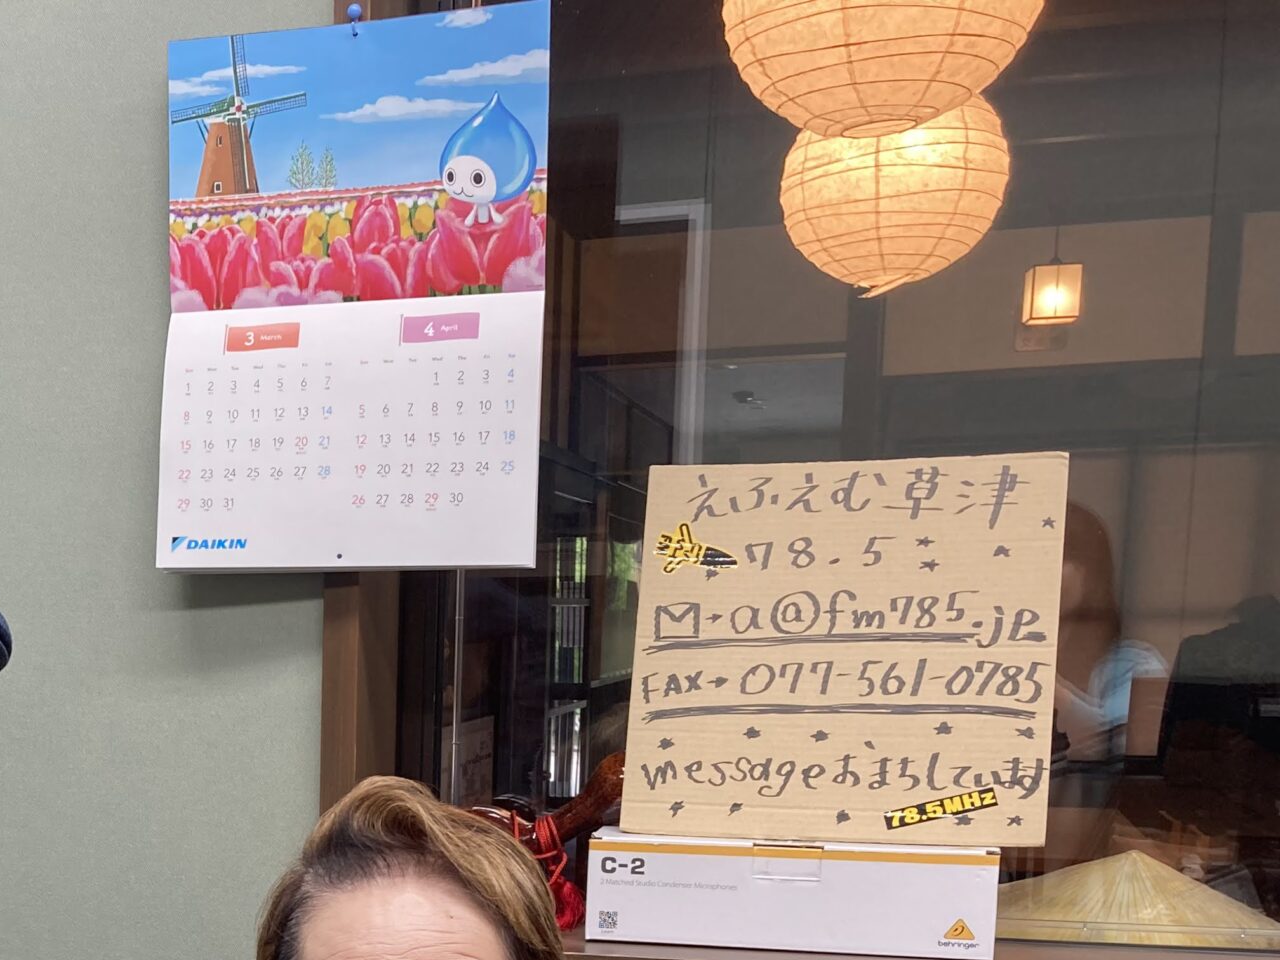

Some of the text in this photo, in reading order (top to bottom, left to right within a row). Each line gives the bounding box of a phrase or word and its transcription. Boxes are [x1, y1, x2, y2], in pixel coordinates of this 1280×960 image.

[423, 321, 459, 337] 4 April
[244, 331, 282, 346] 3 March
[227, 408, 239, 420] 10
[250, 408, 261, 420] 11
[273, 407, 286, 419] 12
[297, 406, 309, 418] 13
[321, 405, 333, 417] 14
[479, 399, 492, 411] 10
[504, 399, 515, 411] 11
[180, 434, 331, 451] 15 16 17 18 19 20 21
[355, 433, 368, 445] 12
[379, 433, 392, 445] 13
[403, 432, 416, 444] 14
[428, 431, 441, 443] 15
[453, 431, 466, 443] 16
[478, 430, 491, 442] 17
[503, 429, 516, 441] 18
[177, 464, 332, 480] 22 23 24 25 26 27 28
[354, 463, 367, 475] 19
[376, 463, 392, 475] 20
[400, 463, 414, 475] 21
[425, 462, 440, 474] 22
[450, 461, 465, 473] 23
[475, 461, 489, 473] 24
[500, 459, 516, 471] 25
[177, 497, 235, 509] 29 30 31
[351, 491, 464, 506] 26 27 28 29 30
[686, 464, 1030, 531] えふえむ草津
[186, 538, 248, 550] DAIKIN
[744, 535, 897, 571] 78.5
[640, 669, 704, 704] FAX
[890, 790, 997, 828] 78.5MHz
[600, 856, 646, 875] C-2
[606, 879, 635, 887] Matched
[636, 880, 656, 888] Studio
[657, 881, 692, 890] Condenser
[693, 882, 738, 892] Microphones
[937, 940, 980, 950] behringer
